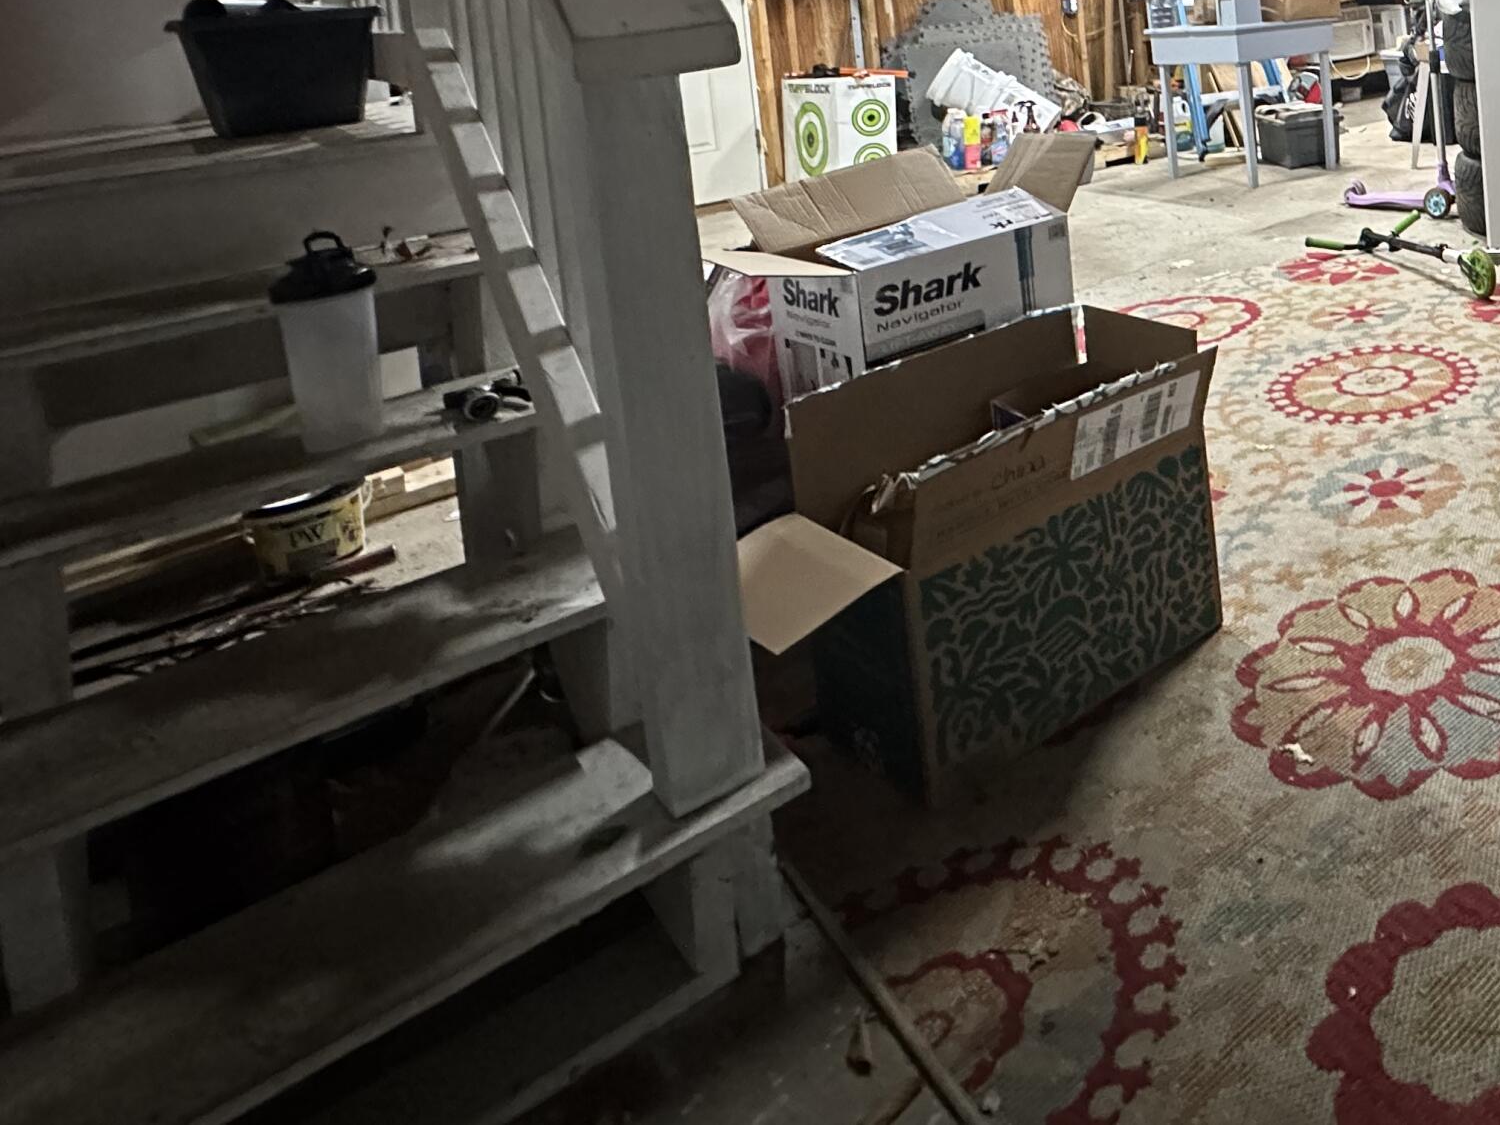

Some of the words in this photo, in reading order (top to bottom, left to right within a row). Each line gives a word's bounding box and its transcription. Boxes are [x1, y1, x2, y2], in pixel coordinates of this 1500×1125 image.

[782, 278, 841, 318] Shark
[873, 261, 987, 317] Shark
[875, 300, 964, 333] Navigator
